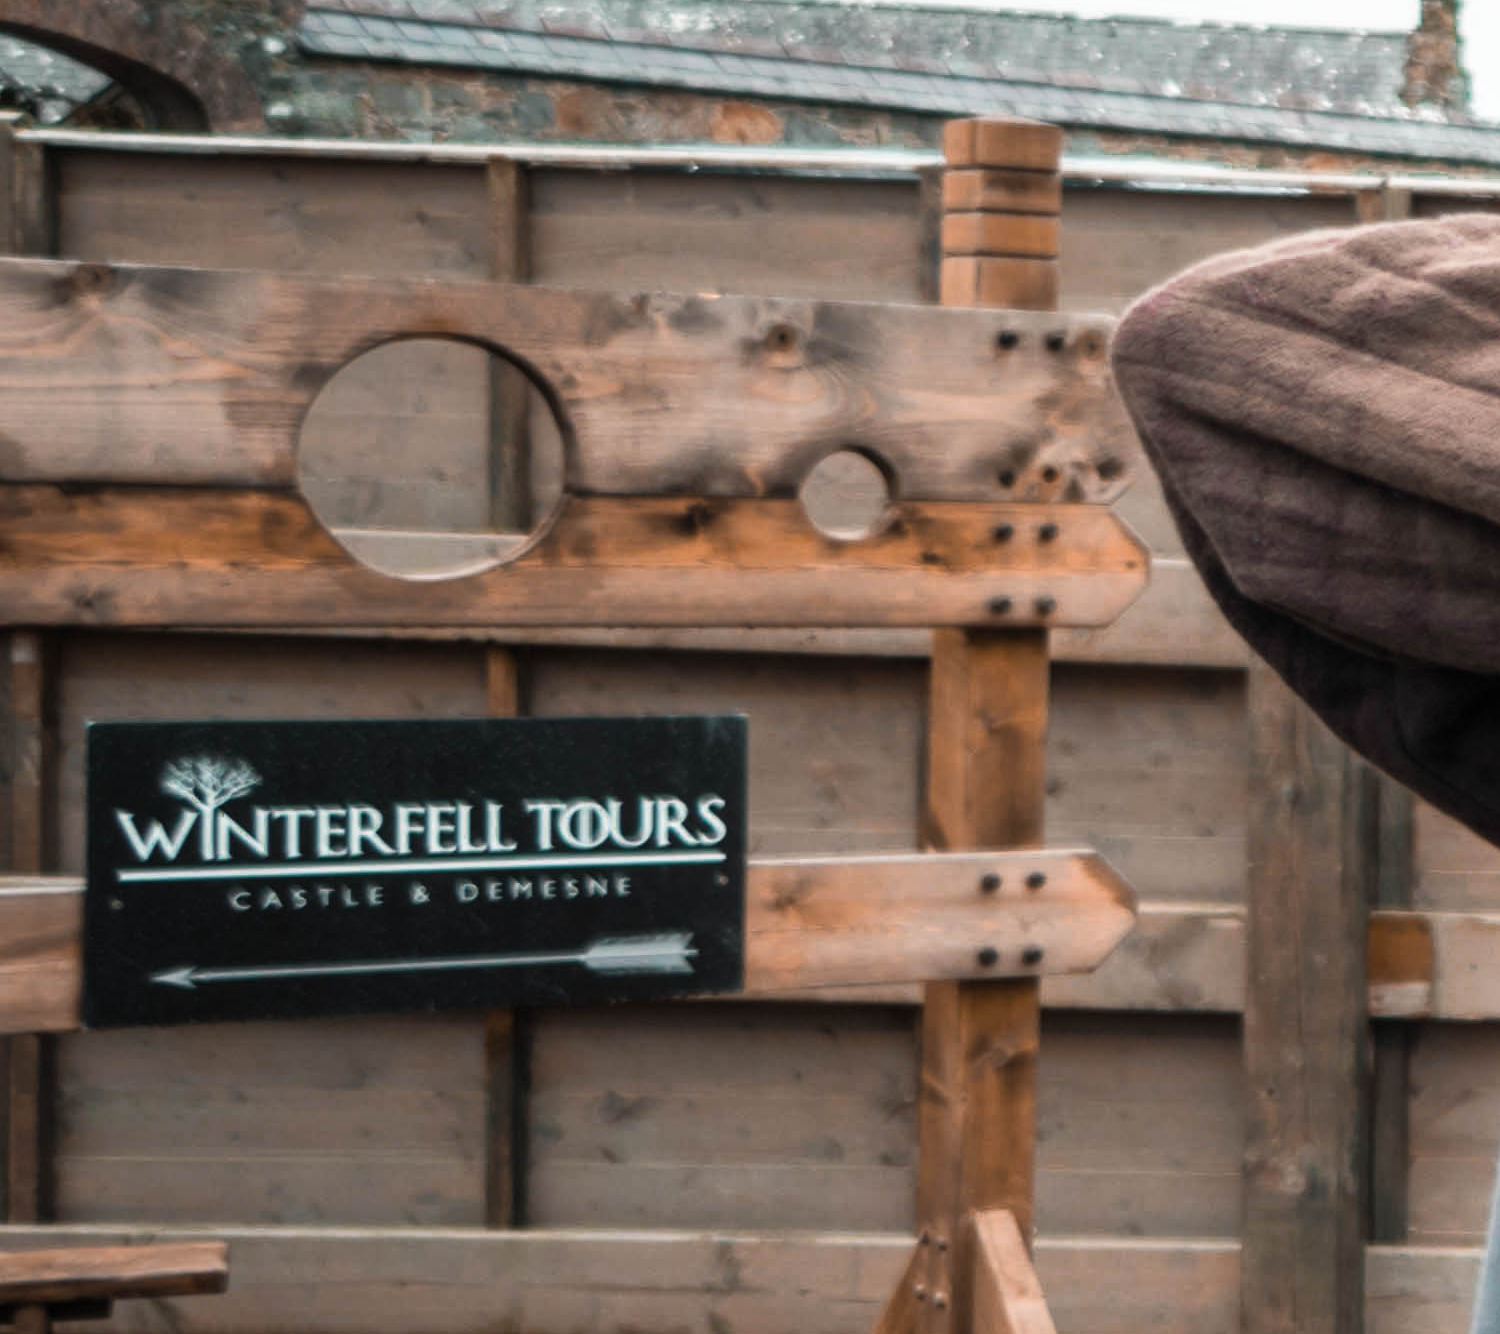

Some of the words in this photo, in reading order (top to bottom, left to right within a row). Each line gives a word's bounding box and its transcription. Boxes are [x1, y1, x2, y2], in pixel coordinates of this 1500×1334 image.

[116, 799, 518, 862] WINTERFELL
[524, 794, 728, 851] TOURS
[230, 884, 384, 911] CASTLE
[411, 884, 431, 904] &
[457, 876, 632, 903] DEMESNE
